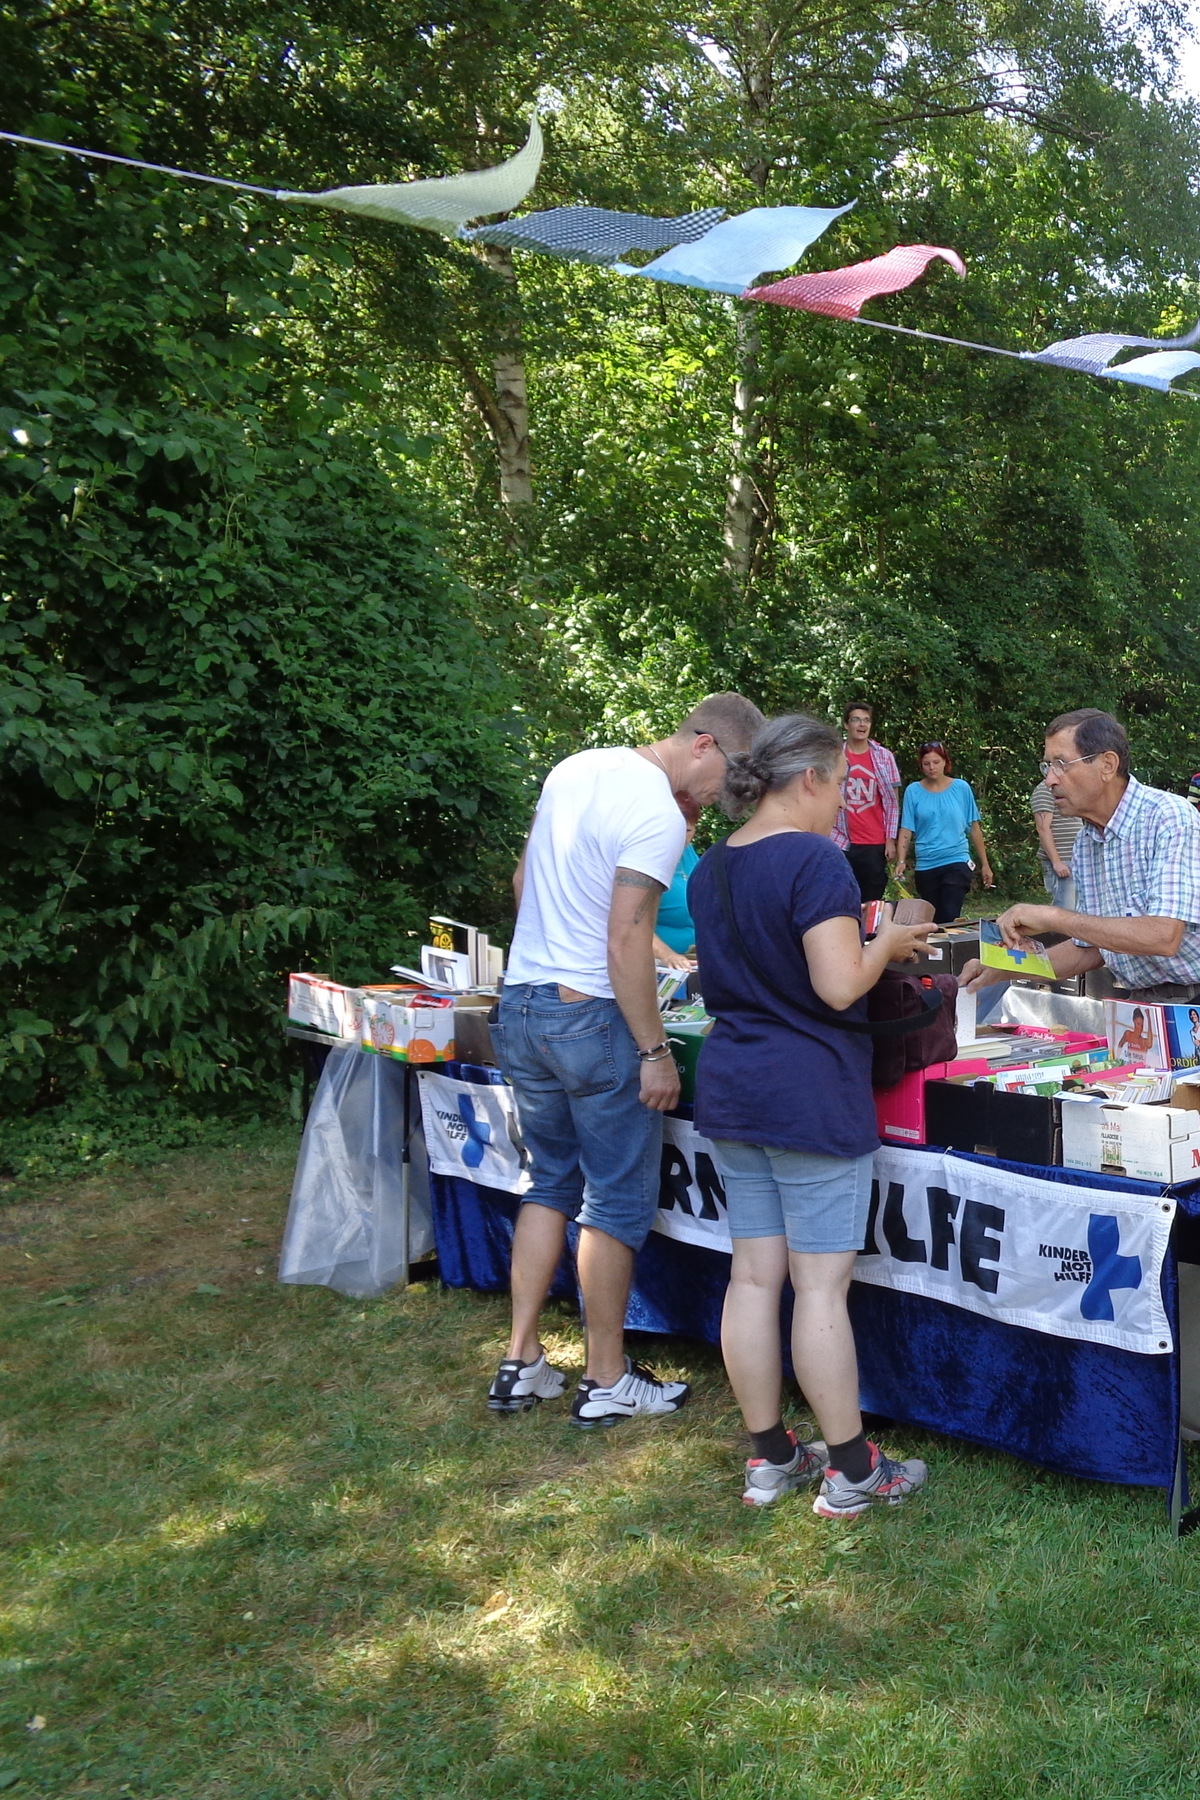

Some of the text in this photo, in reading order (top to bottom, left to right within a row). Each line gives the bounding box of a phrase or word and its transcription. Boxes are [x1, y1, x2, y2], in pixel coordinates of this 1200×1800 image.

[446, 1130, 467, 1141] ILFE
[1039, 1244, 1090, 1261] KINDER
[1061, 1260, 1091, 1272] NOT
[1054, 1272, 1091, 1284] HILFE
